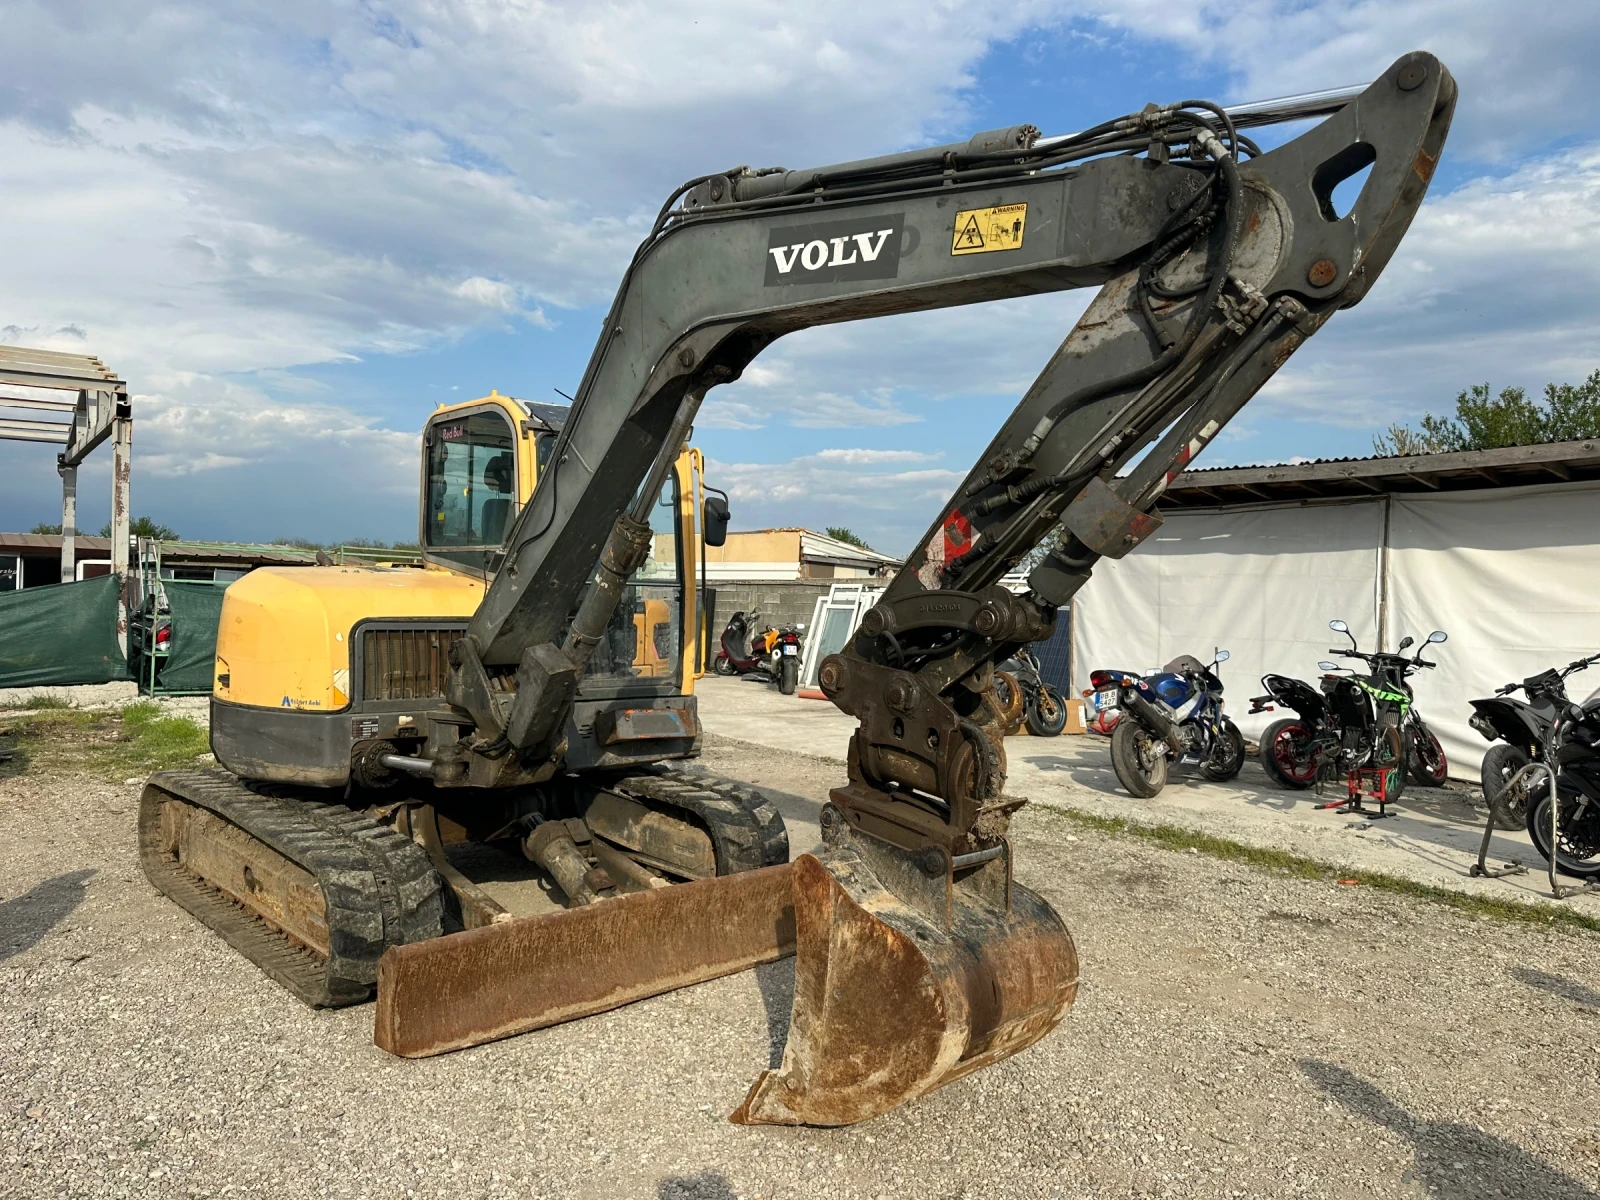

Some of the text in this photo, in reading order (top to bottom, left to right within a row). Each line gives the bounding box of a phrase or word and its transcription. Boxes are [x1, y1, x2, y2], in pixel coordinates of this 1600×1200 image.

[997, 205, 1025, 214] WARNING
[443, 425, 463, 439] Red Bull
[1100, 698, 1116, 707] 5427
